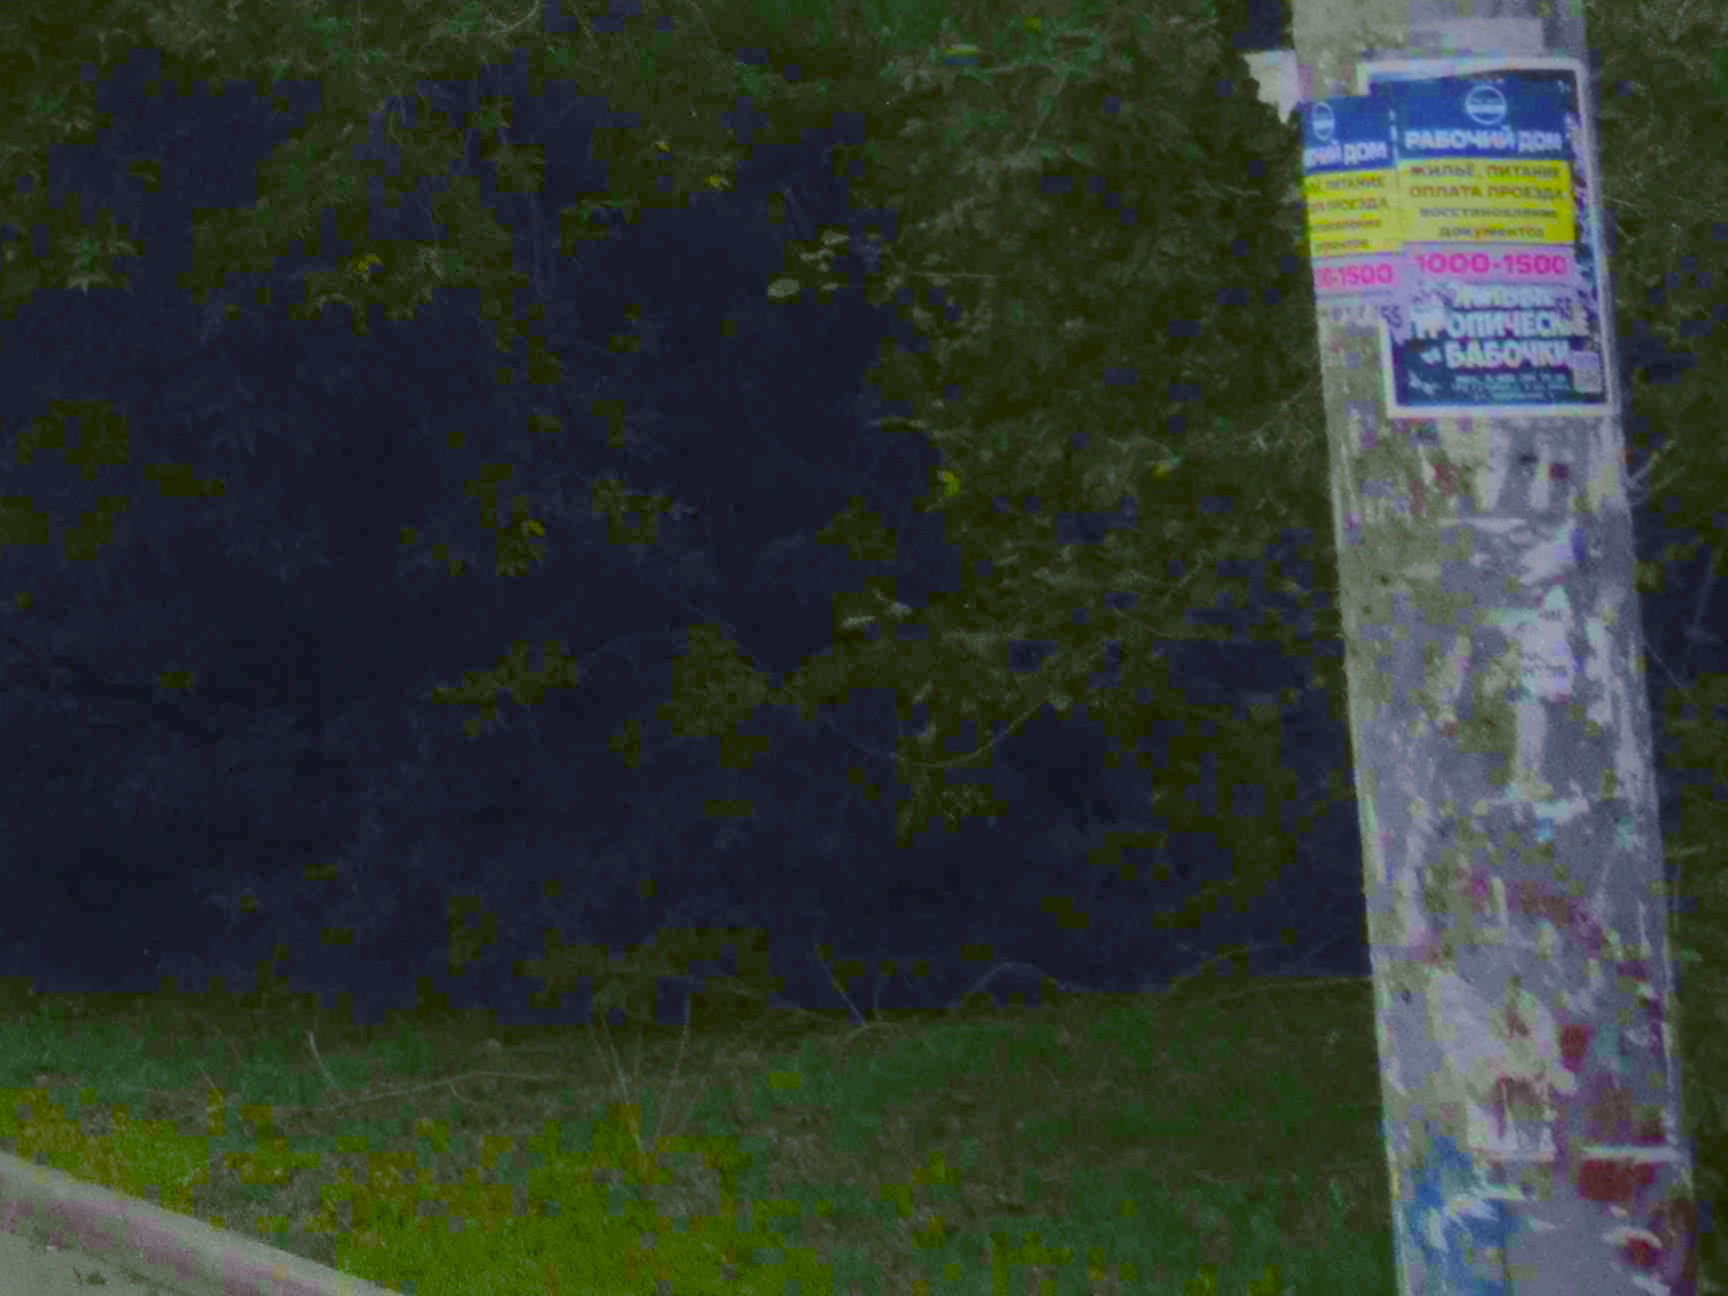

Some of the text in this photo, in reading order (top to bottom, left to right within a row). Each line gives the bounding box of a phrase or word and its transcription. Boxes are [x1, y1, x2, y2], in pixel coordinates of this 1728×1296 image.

[1405, 125, 1564, 152] РАБОЧИЙ ДОМ
[1343, 140, 1388, 166] ДОМ
[1486, 164, 1562, 179] ПИТАНИЕ
[1409, 185, 1564, 201] ОПЛАТА ПРОЕЗДА
[1415, 252, 1567, 275] 1000-1500
[1444, 340, 1571, 370] БАБОЧКИ
